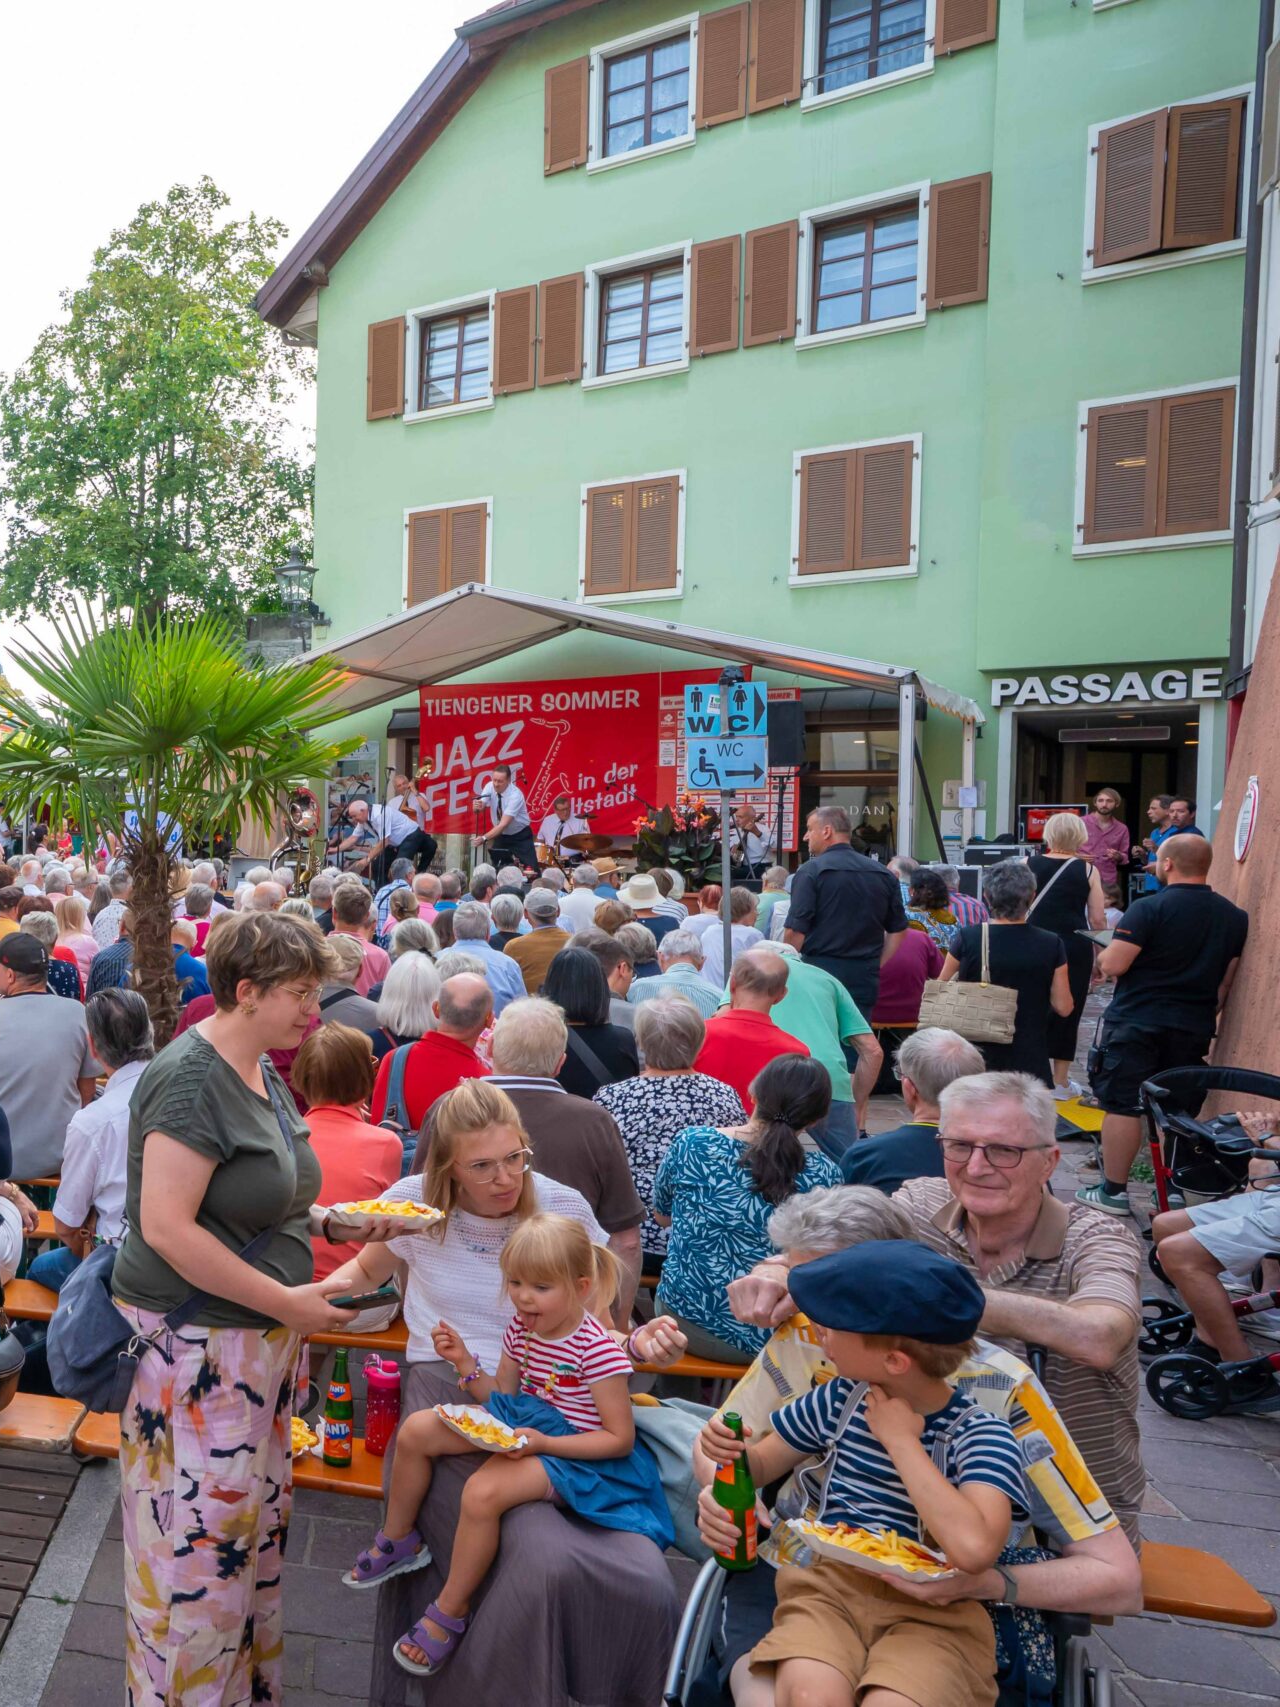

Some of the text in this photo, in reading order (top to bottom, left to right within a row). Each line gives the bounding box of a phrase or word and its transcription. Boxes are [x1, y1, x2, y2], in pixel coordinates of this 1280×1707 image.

[991, 667, 1223, 706] PASSAGE
[425, 688, 640, 717] TIENGENER SOMMER
[687, 715, 750, 735] WC
[428, 719, 525, 780] JAZZ
[716, 742, 744, 757] WC
[578, 762, 638, 790] in der
[570, 783, 637, 815] ltstadt
[325, 1422, 350, 1435] ANTA
